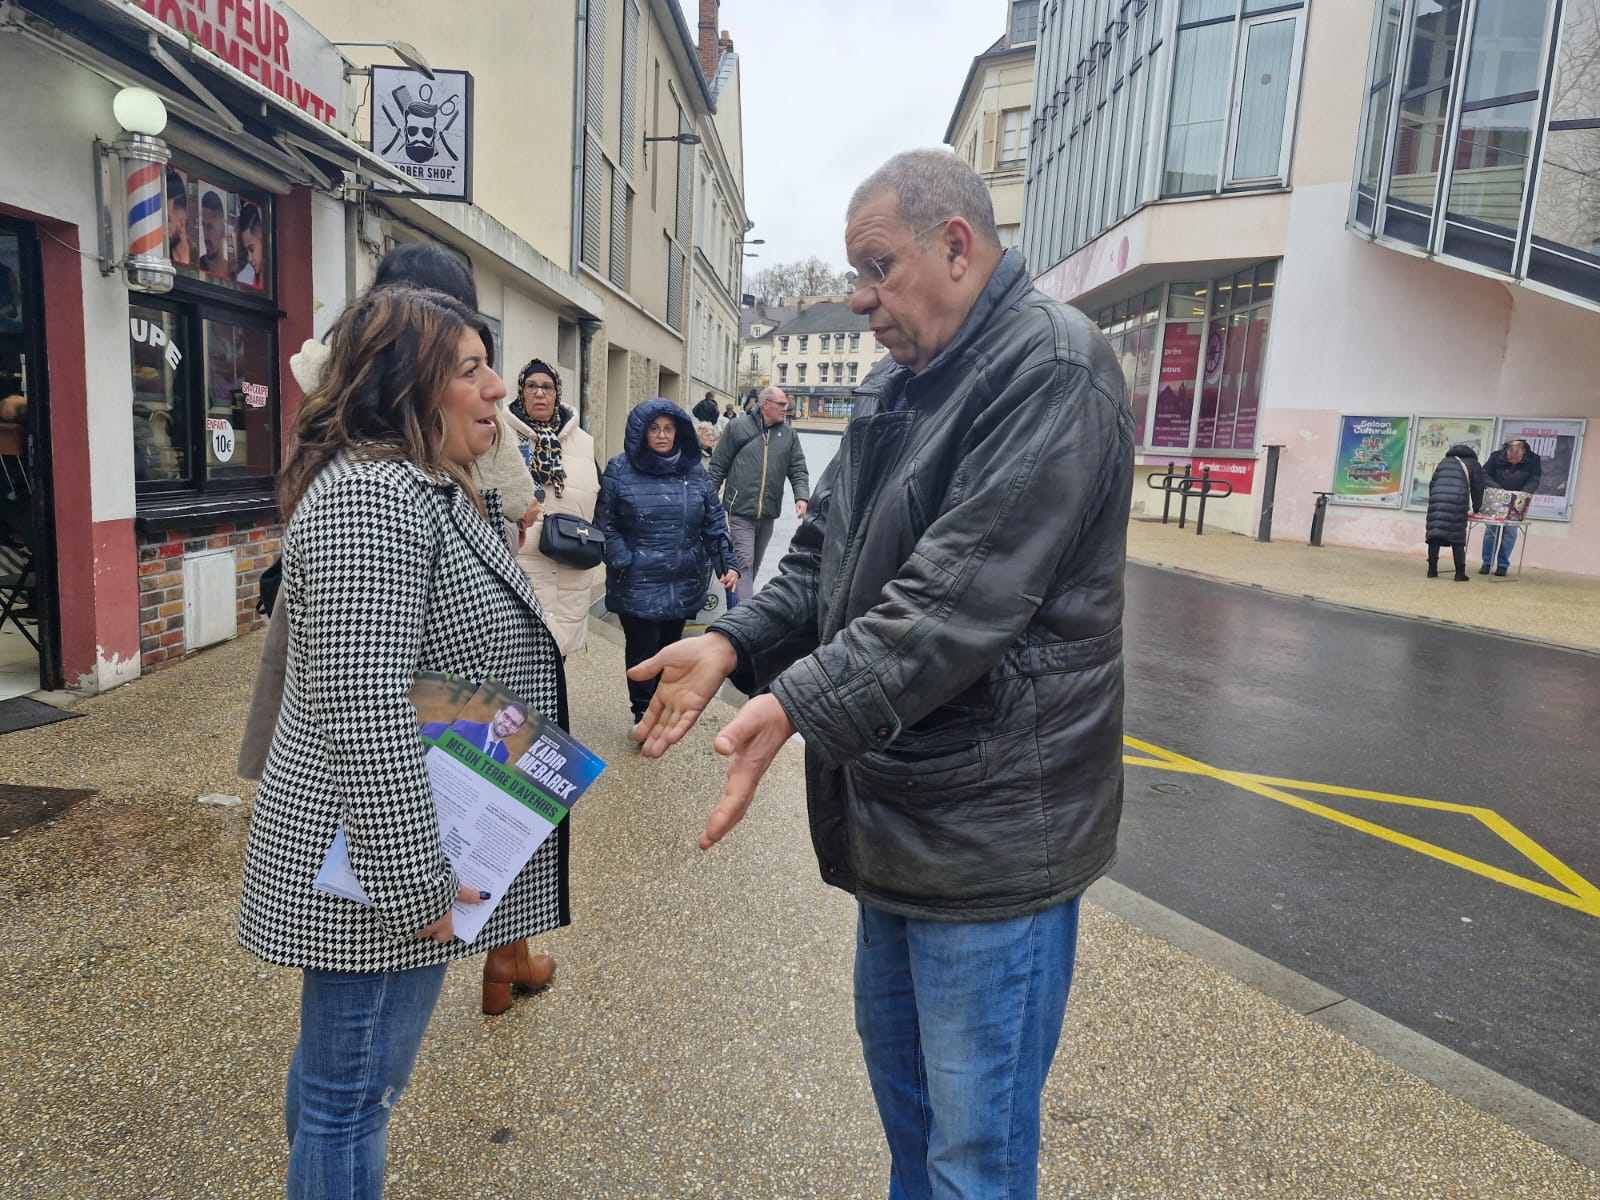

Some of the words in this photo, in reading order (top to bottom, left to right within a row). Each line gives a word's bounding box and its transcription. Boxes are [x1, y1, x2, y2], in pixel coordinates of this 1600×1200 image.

[427, 168, 453, 180] SHOP
[207, 420, 228, 431] ENFANT
[1353, 427, 1398, 436] Culturelle
[1361, 420, 1392, 429] Saison
[215, 434, 232, 453] 10€
[528, 739, 568, 772] KADIR
[446, 737, 483, 766] MELUN
[480, 759, 512, 786] TERRE
[508, 779, 559, 819] D'AVENIRS
[514, 752, 578, 800] MEBAREK
